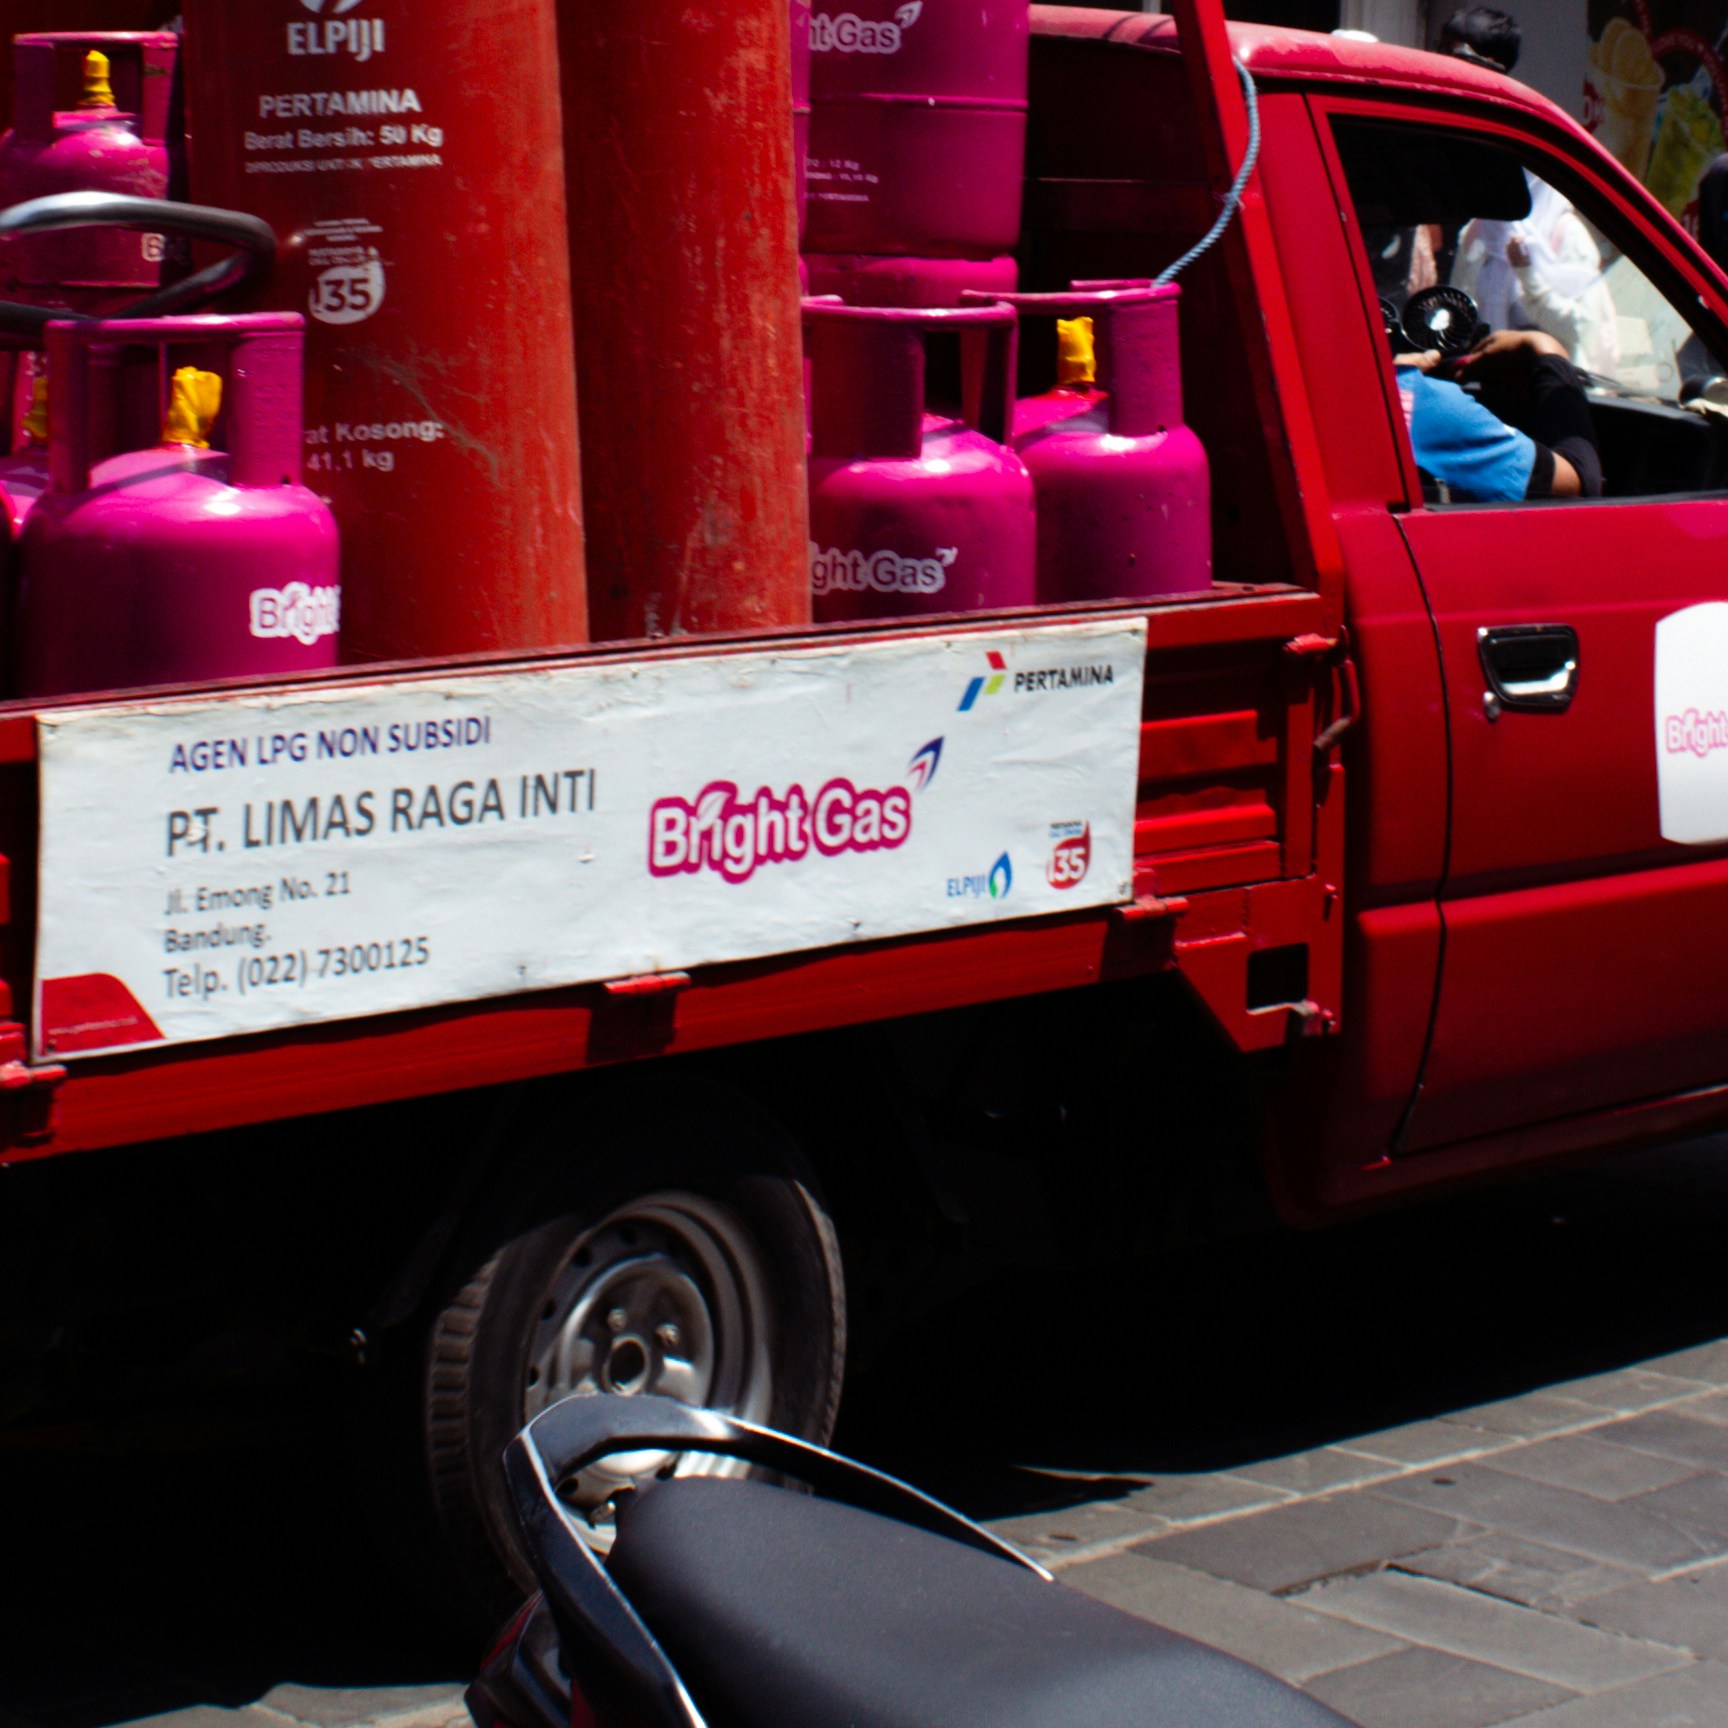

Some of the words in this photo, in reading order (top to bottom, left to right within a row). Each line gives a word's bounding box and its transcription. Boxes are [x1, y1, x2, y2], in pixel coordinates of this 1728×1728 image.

[286, 18, 386, 62] ELPIJI
[835, 14, 901, 54] Gas
[259, 88, 423, 118] PERTAMINA
[244, 131, 295, 151] Berat
[297, 127, 374, 149] Bersih:
[379, 125, 406, 146] 50
[410, 123, 444, 148] Kg
[335, 420, 446, 442] Kosong:
[306, 450, 354, 472] 41.1
[362, 448, 395, 472] kg
[871, 550, 946, 594] Gas
[1014, 664, 1114, 694] PERTAMINA
[170, 738, 248, 774] AGEN
[256, 732, 308, 767] LPG
[315, 725, 380, 760] NON
[388, 715, 492, 753] SUBSIDI
[167, 806, 227, 858] PT.
[242, 790, 375, 849] LIMAS
[389, 778, 506, 833] RAGA
[518, 767, 597, 819] INTI
[649, 780, 809, 885] Bright
[811, 777, 912, 858] Gas
[165, 889, 189, 916] Jl.
[195, 882, 274, 913] Emong
[279, 876, 319, 904] No.
[325, 871, 352, 898] 21
[163, 923, 272, 955] Bandung.
[163, 967, 229, 1002] Telp.
[237, 951, 309, 996] (022)
[316, 935, 431, 982] 7300125
